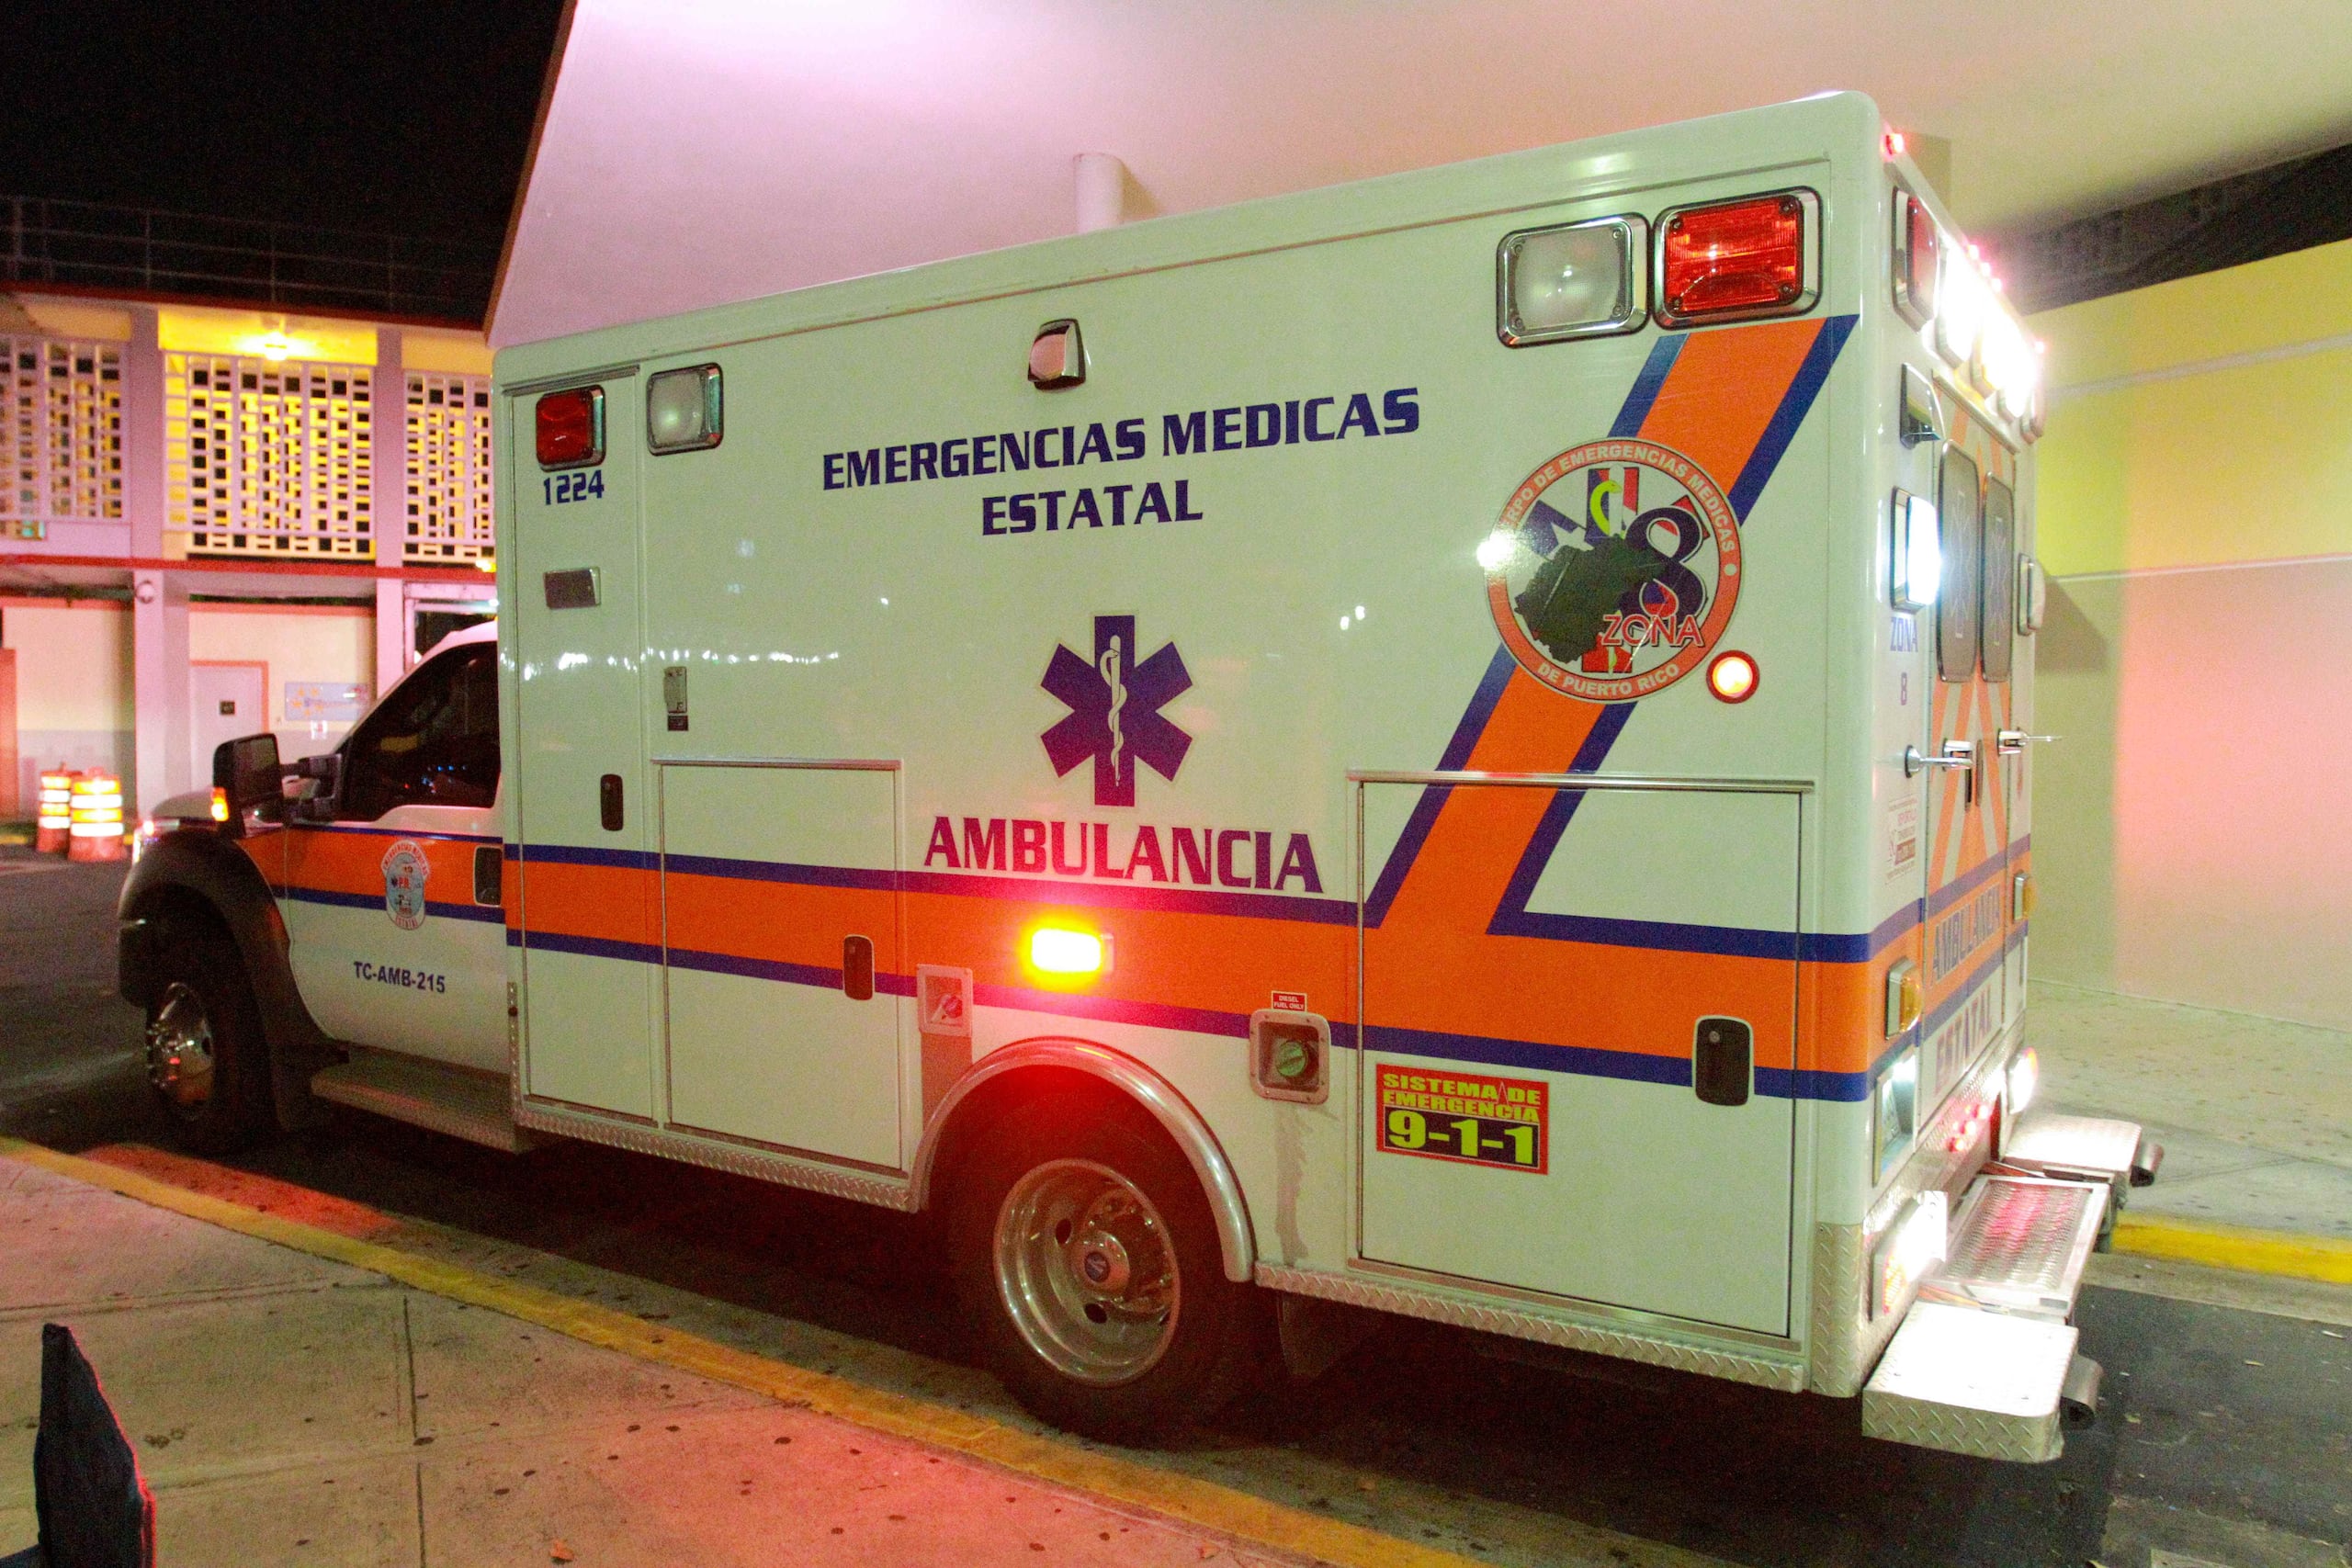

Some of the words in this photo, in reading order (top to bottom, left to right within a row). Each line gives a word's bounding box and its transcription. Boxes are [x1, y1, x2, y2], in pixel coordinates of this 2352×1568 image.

[823, 418, 1147, 491] EMERGENCIAS
[1162, 388, 1419, 457] MEDICAS
[543, 469, 605, 505] 1224
[1533, 466, 1558, 488] DE
[1558, 444, 1689, 478] EMERGENCIAS
[1687, 474, 1736, 552] MEDICAS
[981, 479, 1204, 536] ESTATAL
[1619, 506, 1707, 629] 8
[1601, 614, 1704, 647] ZONA
[1890, 616, 1918, 652] ZONA
[1537, 662, 1559, 683] DE
[1563, 676, 1632, 696] PUERTO
[1636, 663, 1679, 692] RICO
[1900, 671, 1908, 705] 8
[923, 816, 1324, 894] AMBULANCIA
[354, 961, 446, 993] TC-AMB-215
[1935, 982, 1991, 1096] ESTATAL
[1383, 1073, 1498, 1101] SISTEMA
[1507, 1088, 1541, 1104] DE
[1383, 1090, 1540, 1122] EMERGENCIA
[1388, 1110, 1533, 1165] 9-1-1
